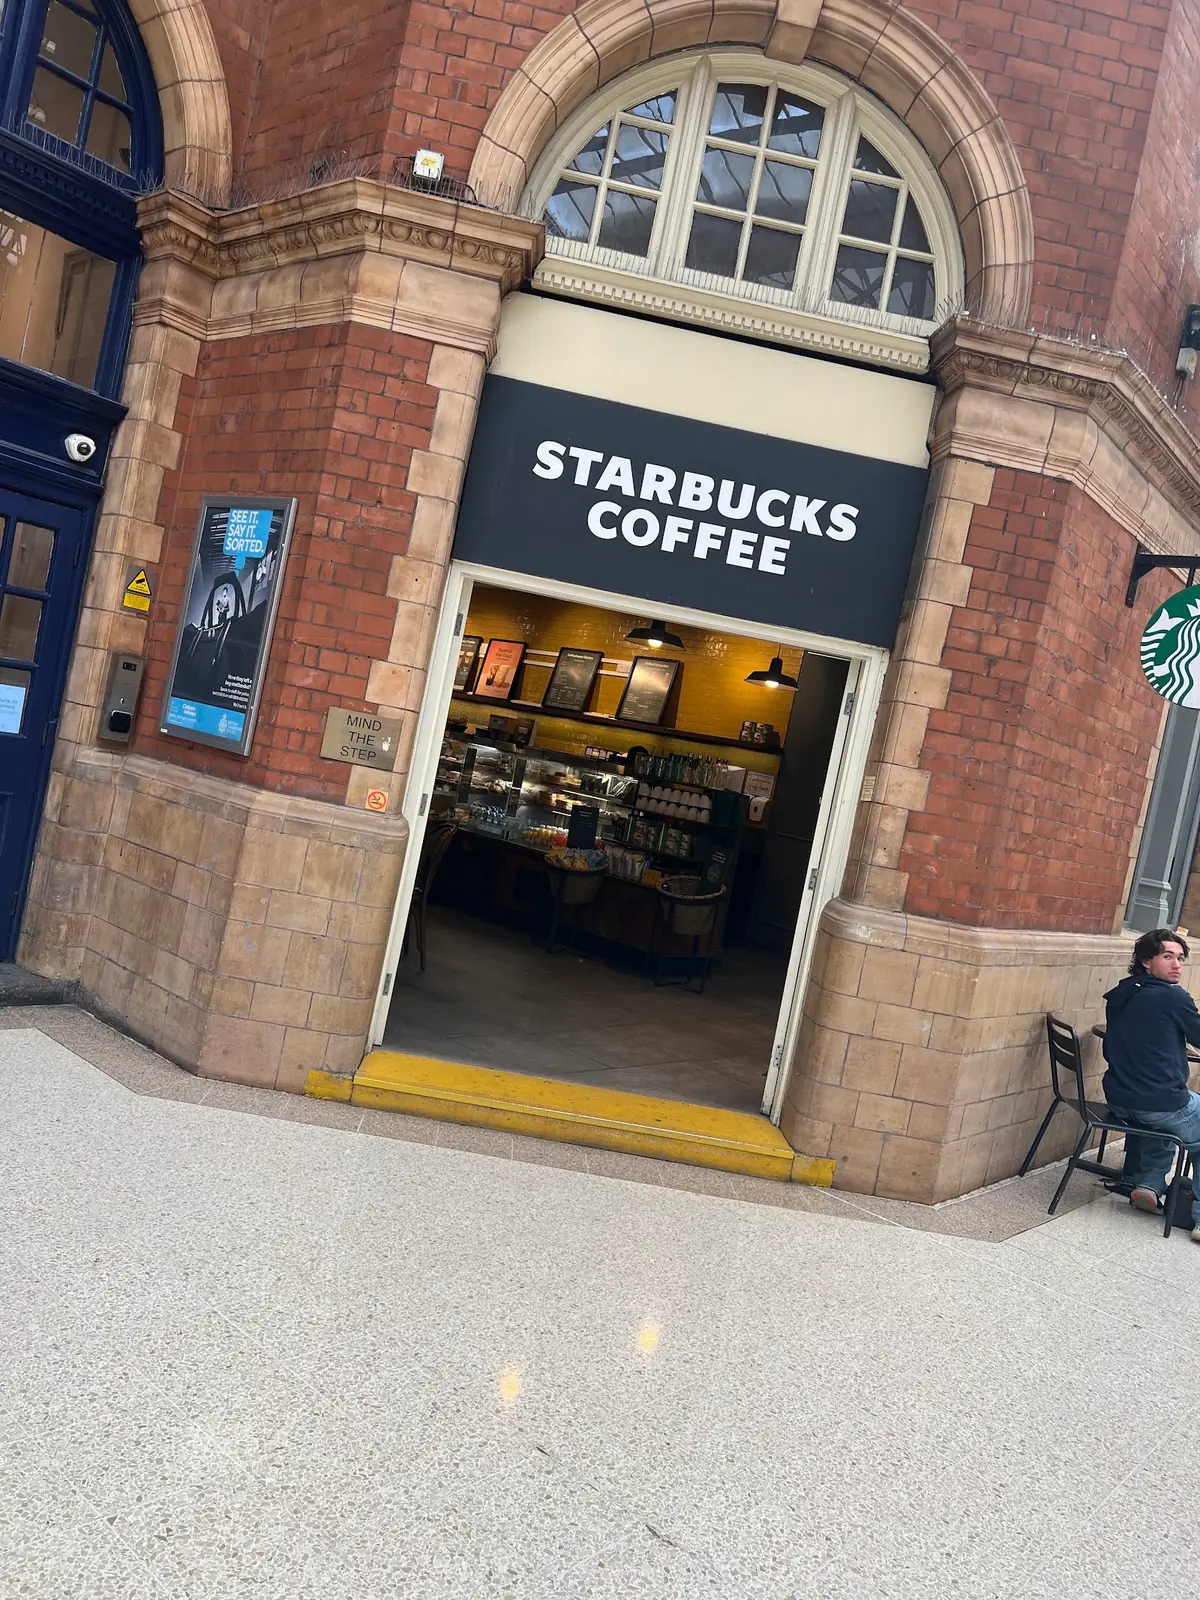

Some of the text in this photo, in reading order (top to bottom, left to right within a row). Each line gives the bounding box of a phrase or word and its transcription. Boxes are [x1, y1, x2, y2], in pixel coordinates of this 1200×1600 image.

[532, 440, 860, 542] STARBUCKS
[230, 510, 258, 524] SEE IT.
[227, 524, 256, 538] SAY IT.
[587, 501, 791, 575] COFFEE
[225, 538, 264, 553] SORTED.
[346, 714, 382, 732] MIND
[348, 731, 376, 747] THE
[340, 745, 377, 761] STEP
